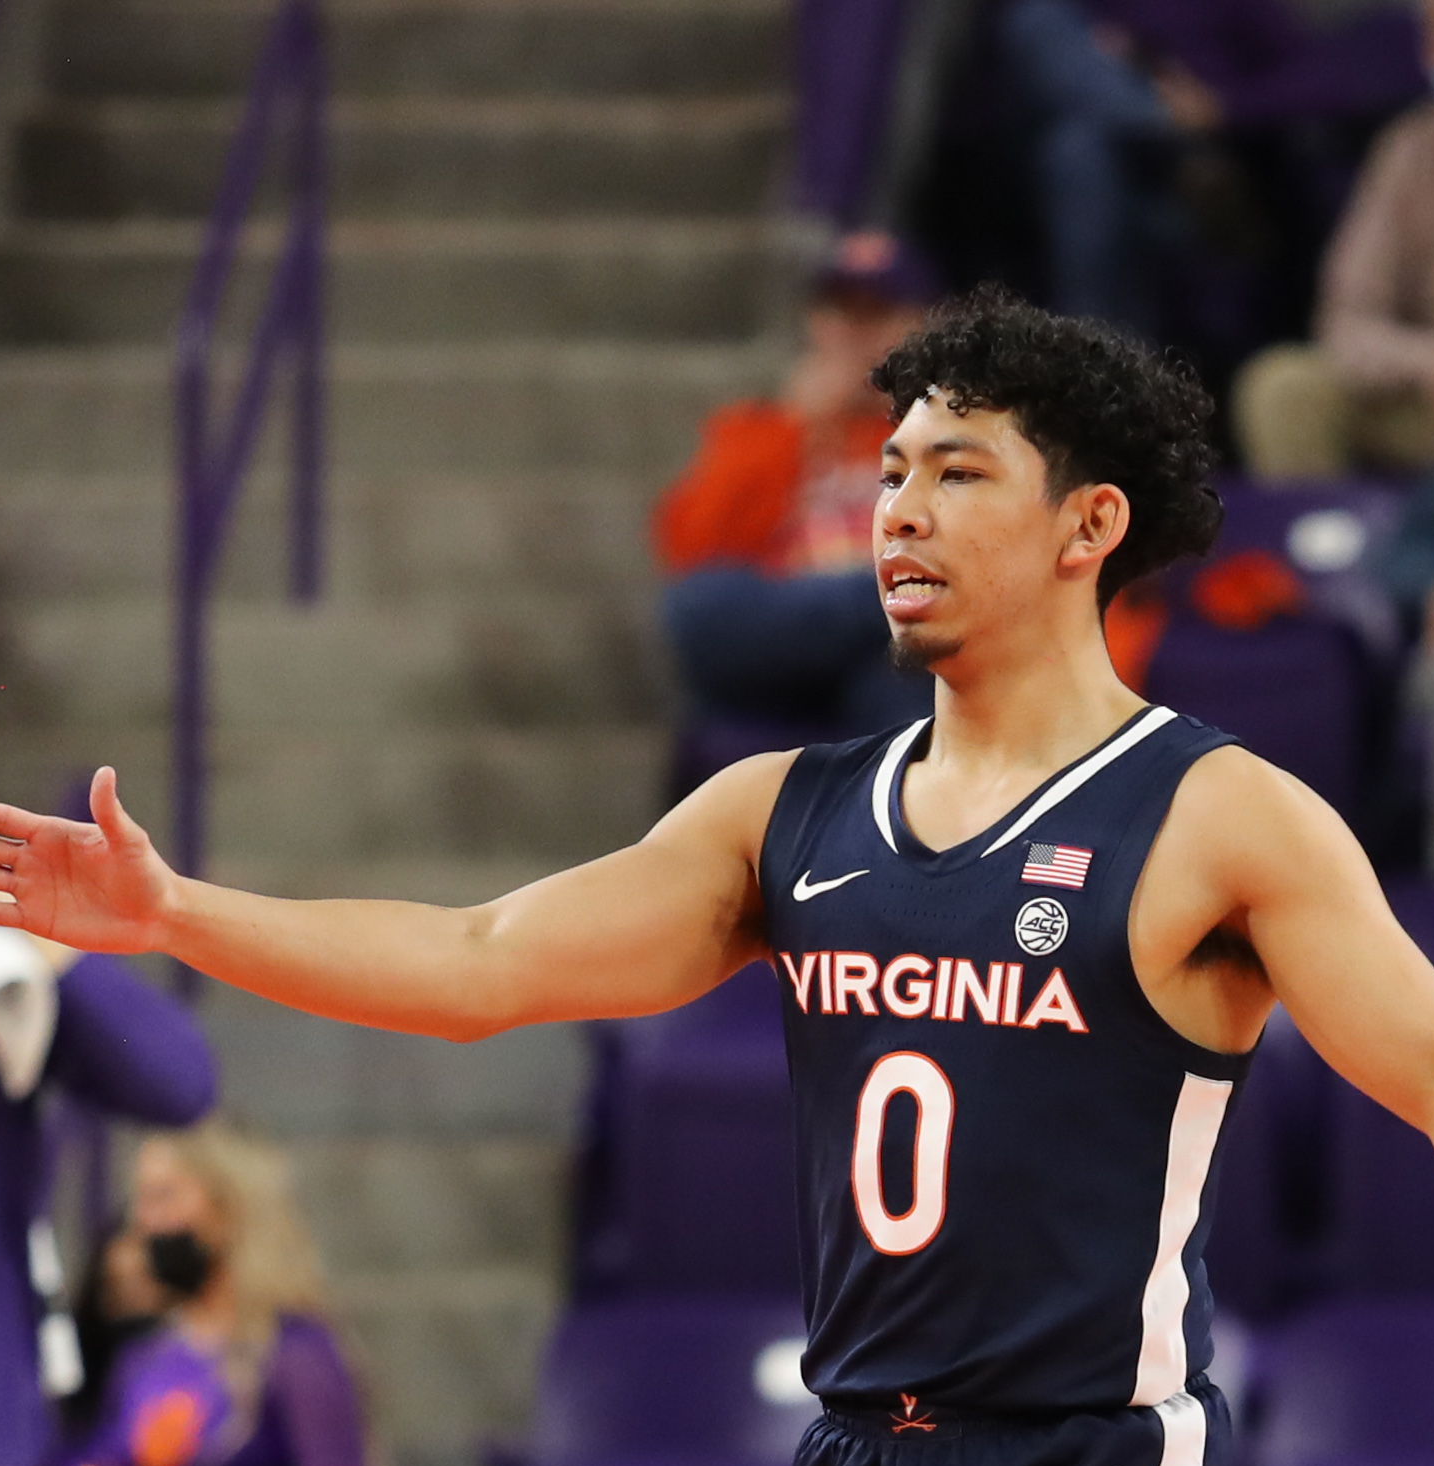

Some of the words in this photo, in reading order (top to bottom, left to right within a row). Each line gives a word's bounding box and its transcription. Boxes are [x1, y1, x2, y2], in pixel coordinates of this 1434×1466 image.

[1024, 916, 1065, 934] ACC
[778, 950, 1090, 1034] VIRGINIA
[851, 1049, 955, 1256] 0
